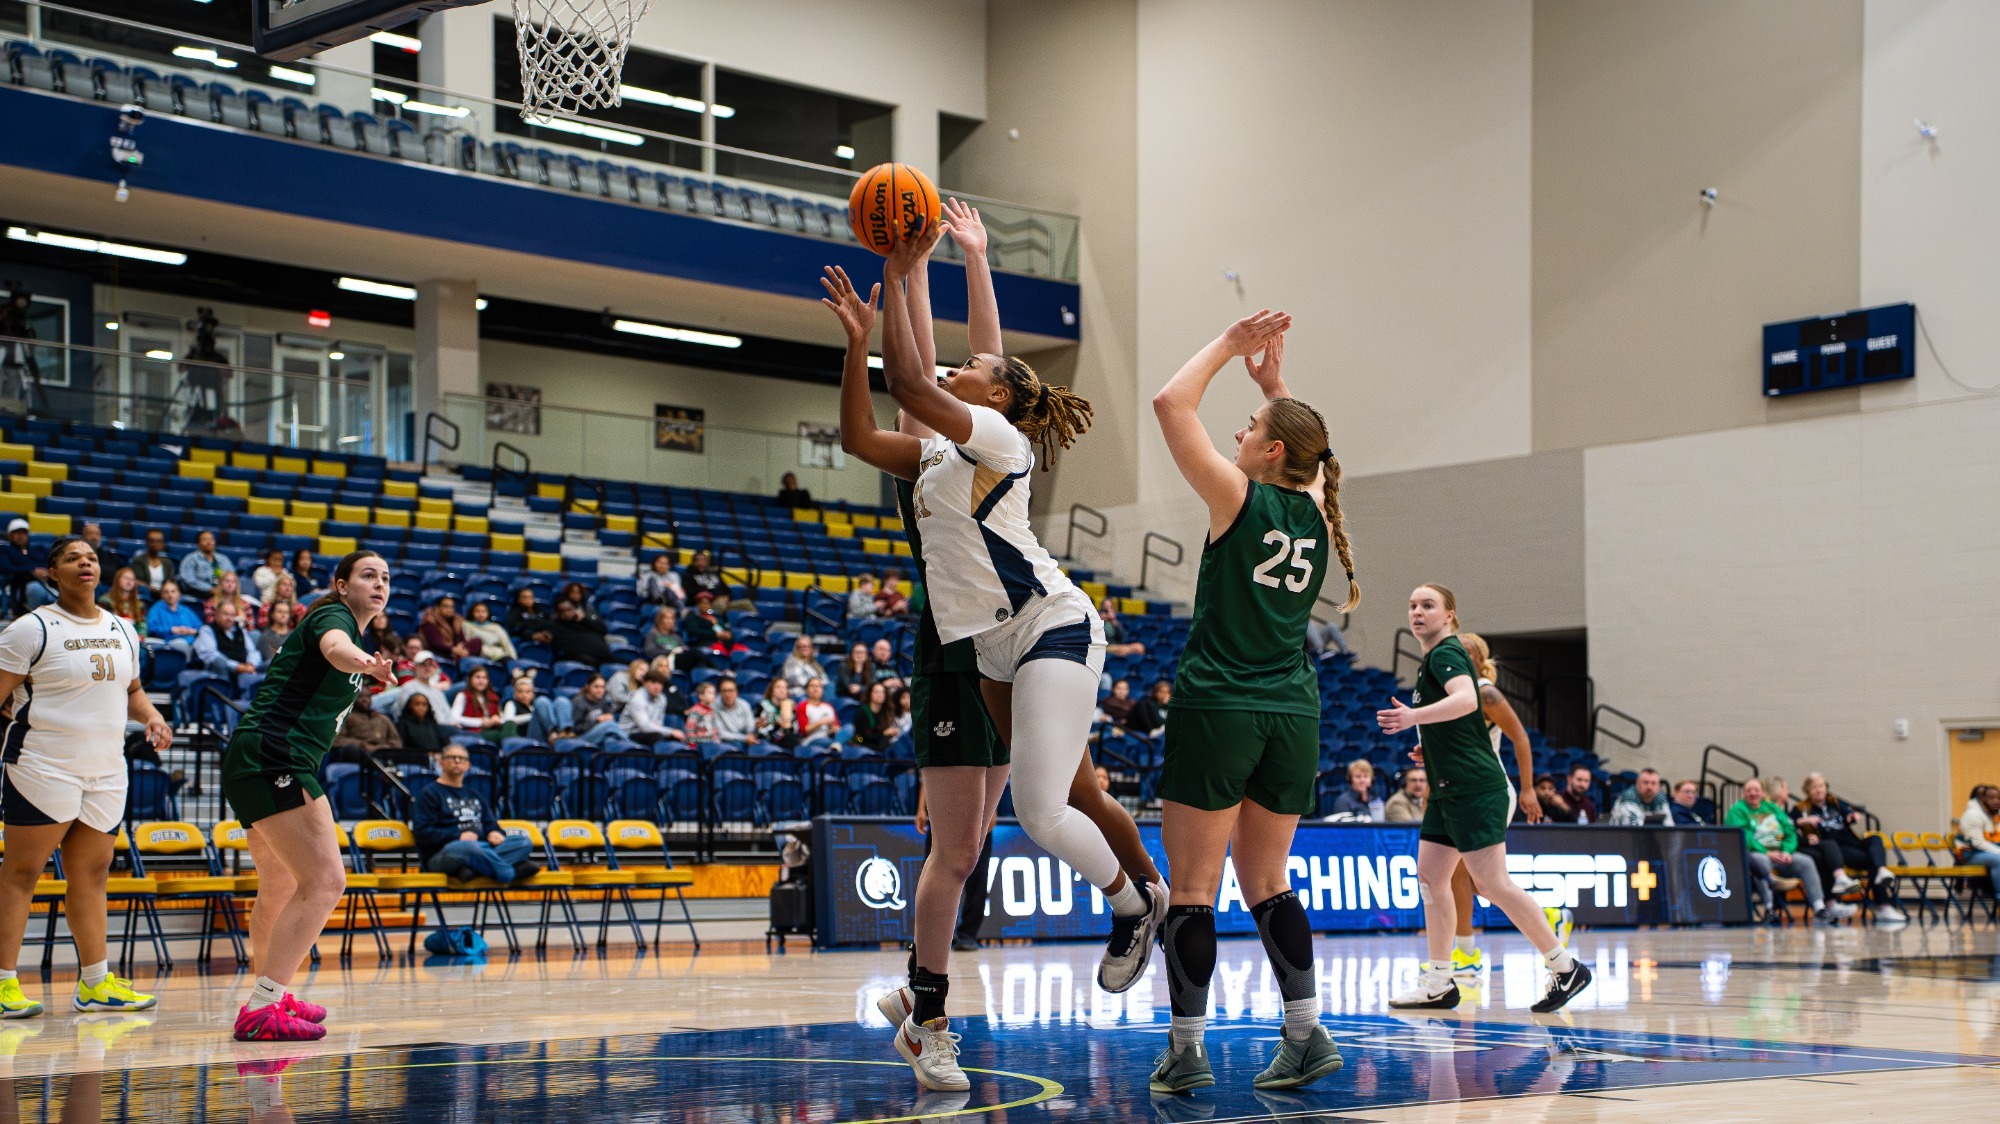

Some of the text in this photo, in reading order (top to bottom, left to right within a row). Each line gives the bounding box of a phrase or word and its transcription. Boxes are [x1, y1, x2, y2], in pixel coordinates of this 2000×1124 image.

[870, 182, 889, 246] Wilson
[1867, 335, 1898, 351] GUEST
[1772, 350, 1798, 364] HOME
[1253, 529, 1316, 593] 25
[64, 639, 122, 651] QUEENS
[90, 654, 116, 681] 31
[150, 830, 189, 843] QUEENS
